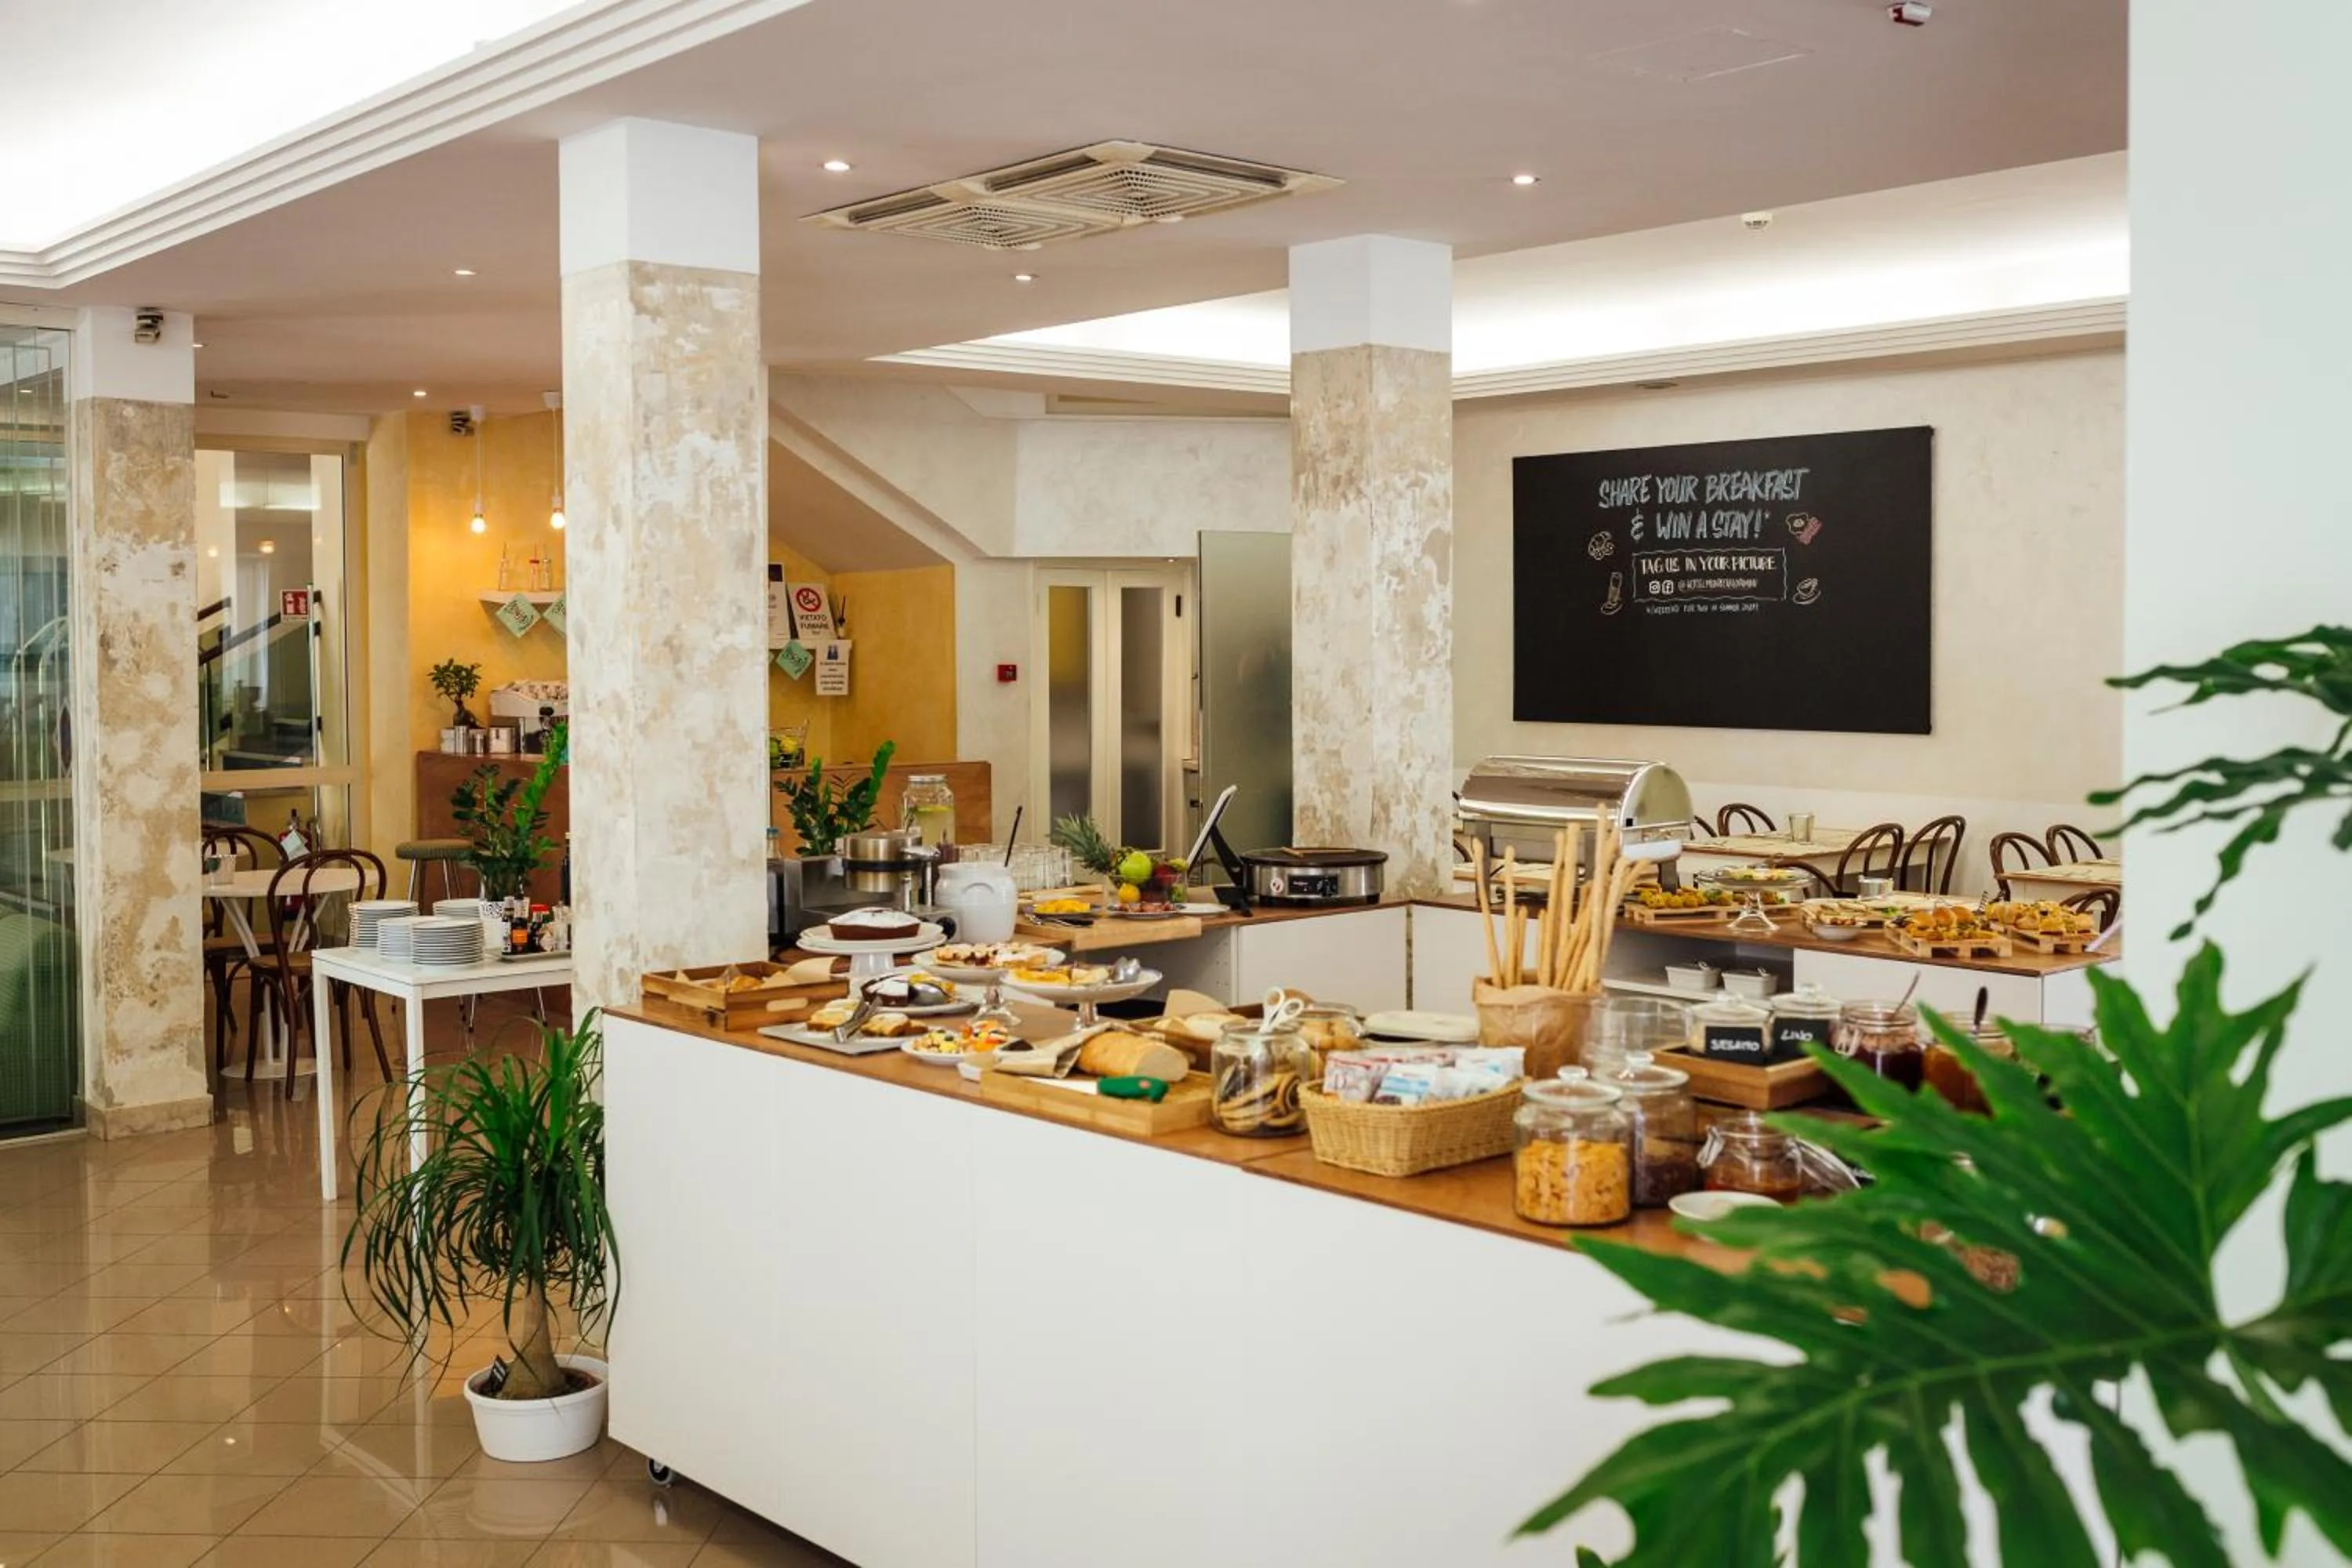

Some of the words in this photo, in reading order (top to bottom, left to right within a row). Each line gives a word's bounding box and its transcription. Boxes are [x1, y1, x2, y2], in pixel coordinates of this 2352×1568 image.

[1599, 474, 1652, 508] SHARE
[1655, 475, 1700, 504] YOUR
[1704, 468, 1809, 504] BREAKFAST
[1656, 510, 1691, 539] WIN
[1695, 510, 1708, 539] A
[1641, 557, 1664, 575] TAG
[1664, 557, 1680, 573] US
[1685, 557, 1697, 572] IN
[1699, 556, 1731, 572] YOUR
[1731, 555, 1777, 572] PICTURE
[1710, 1039, 1759, 1051] SESAMO
[1780, 1029, 1813, 1042] LINO
